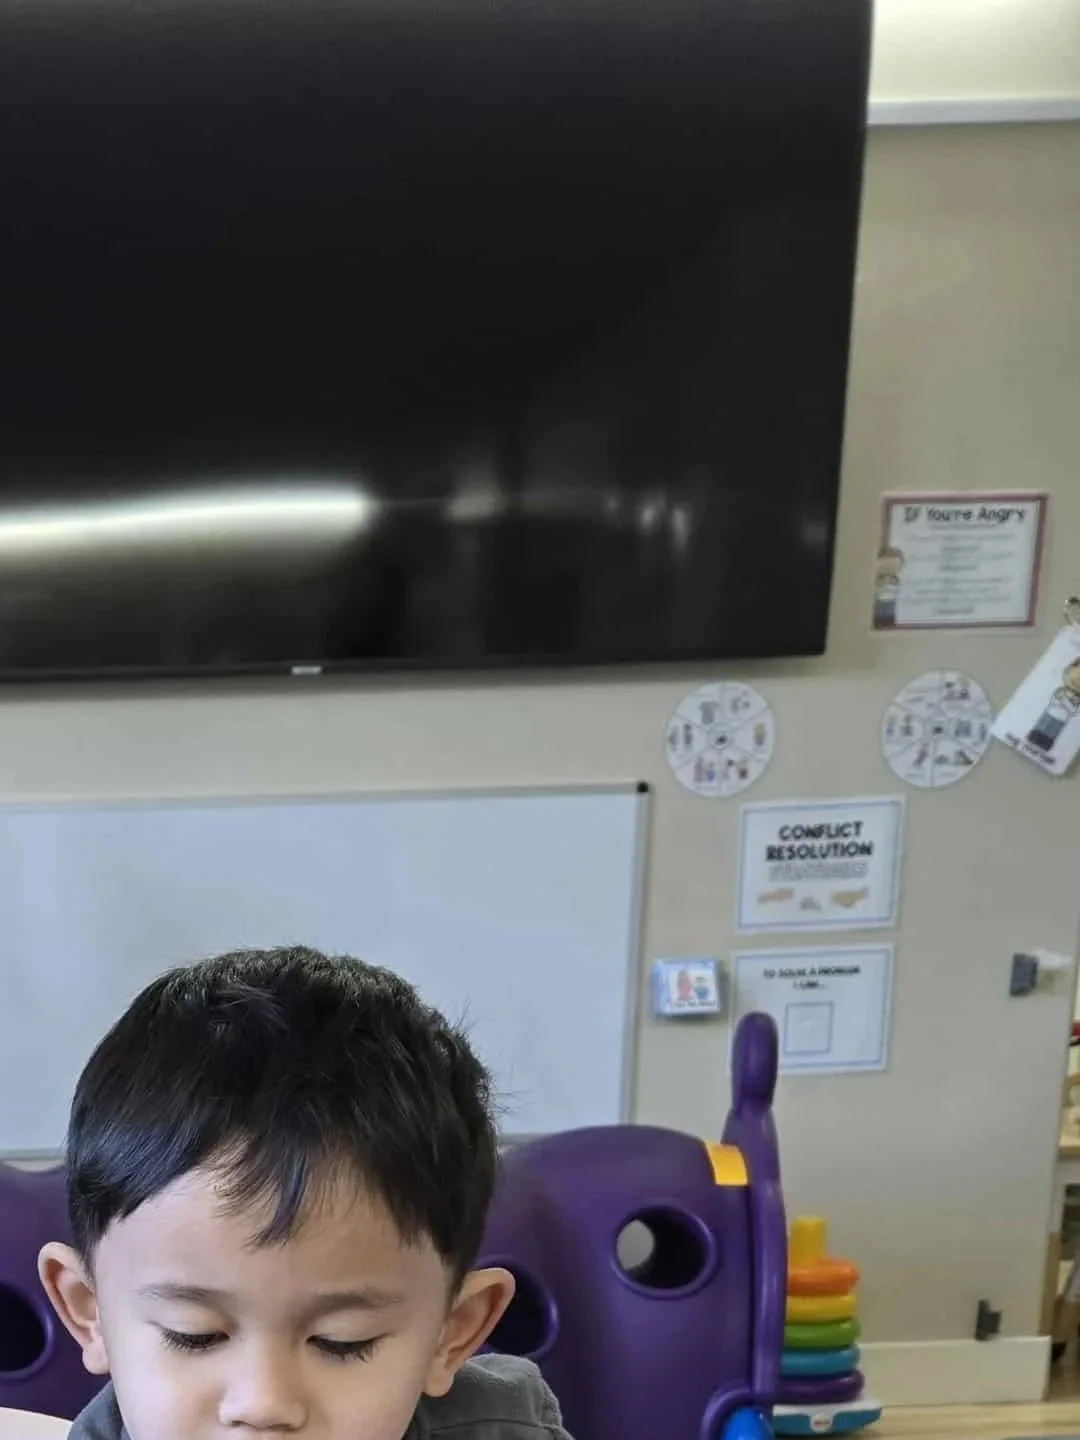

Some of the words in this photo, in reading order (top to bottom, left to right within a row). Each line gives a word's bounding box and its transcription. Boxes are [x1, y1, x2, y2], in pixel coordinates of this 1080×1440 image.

[978, 506, 1025, 523] Angry
[778, 820, 863, 841] CONFLICT
[765, 840, 874, 862] RESOLUTION
